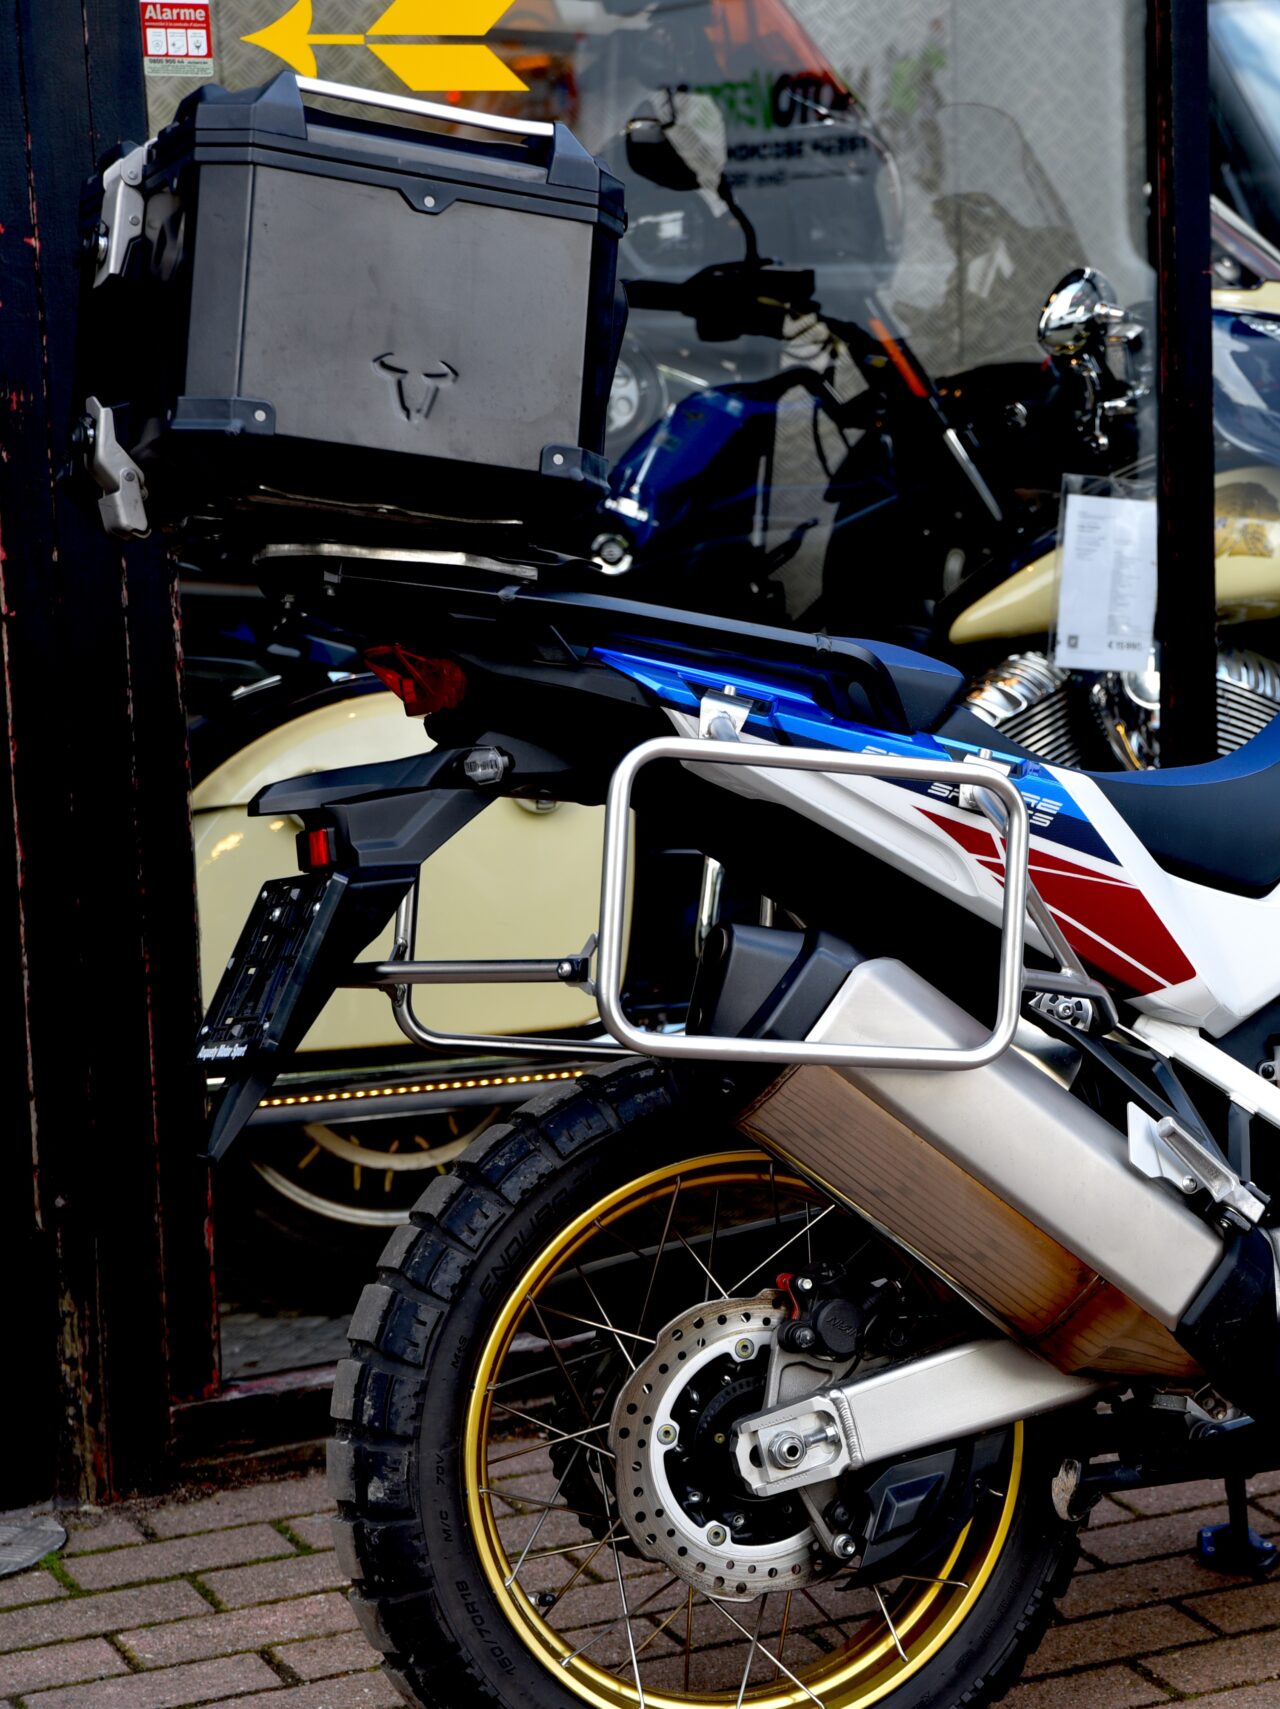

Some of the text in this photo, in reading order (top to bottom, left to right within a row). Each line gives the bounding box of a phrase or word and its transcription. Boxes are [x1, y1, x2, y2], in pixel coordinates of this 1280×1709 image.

[144, 4, 206, 21] Alarme
[451, 1334, 469, 1370] M+S
[435, 1453, 446, 1486] 70V
[439, 1509, 454, 1543] M/C
